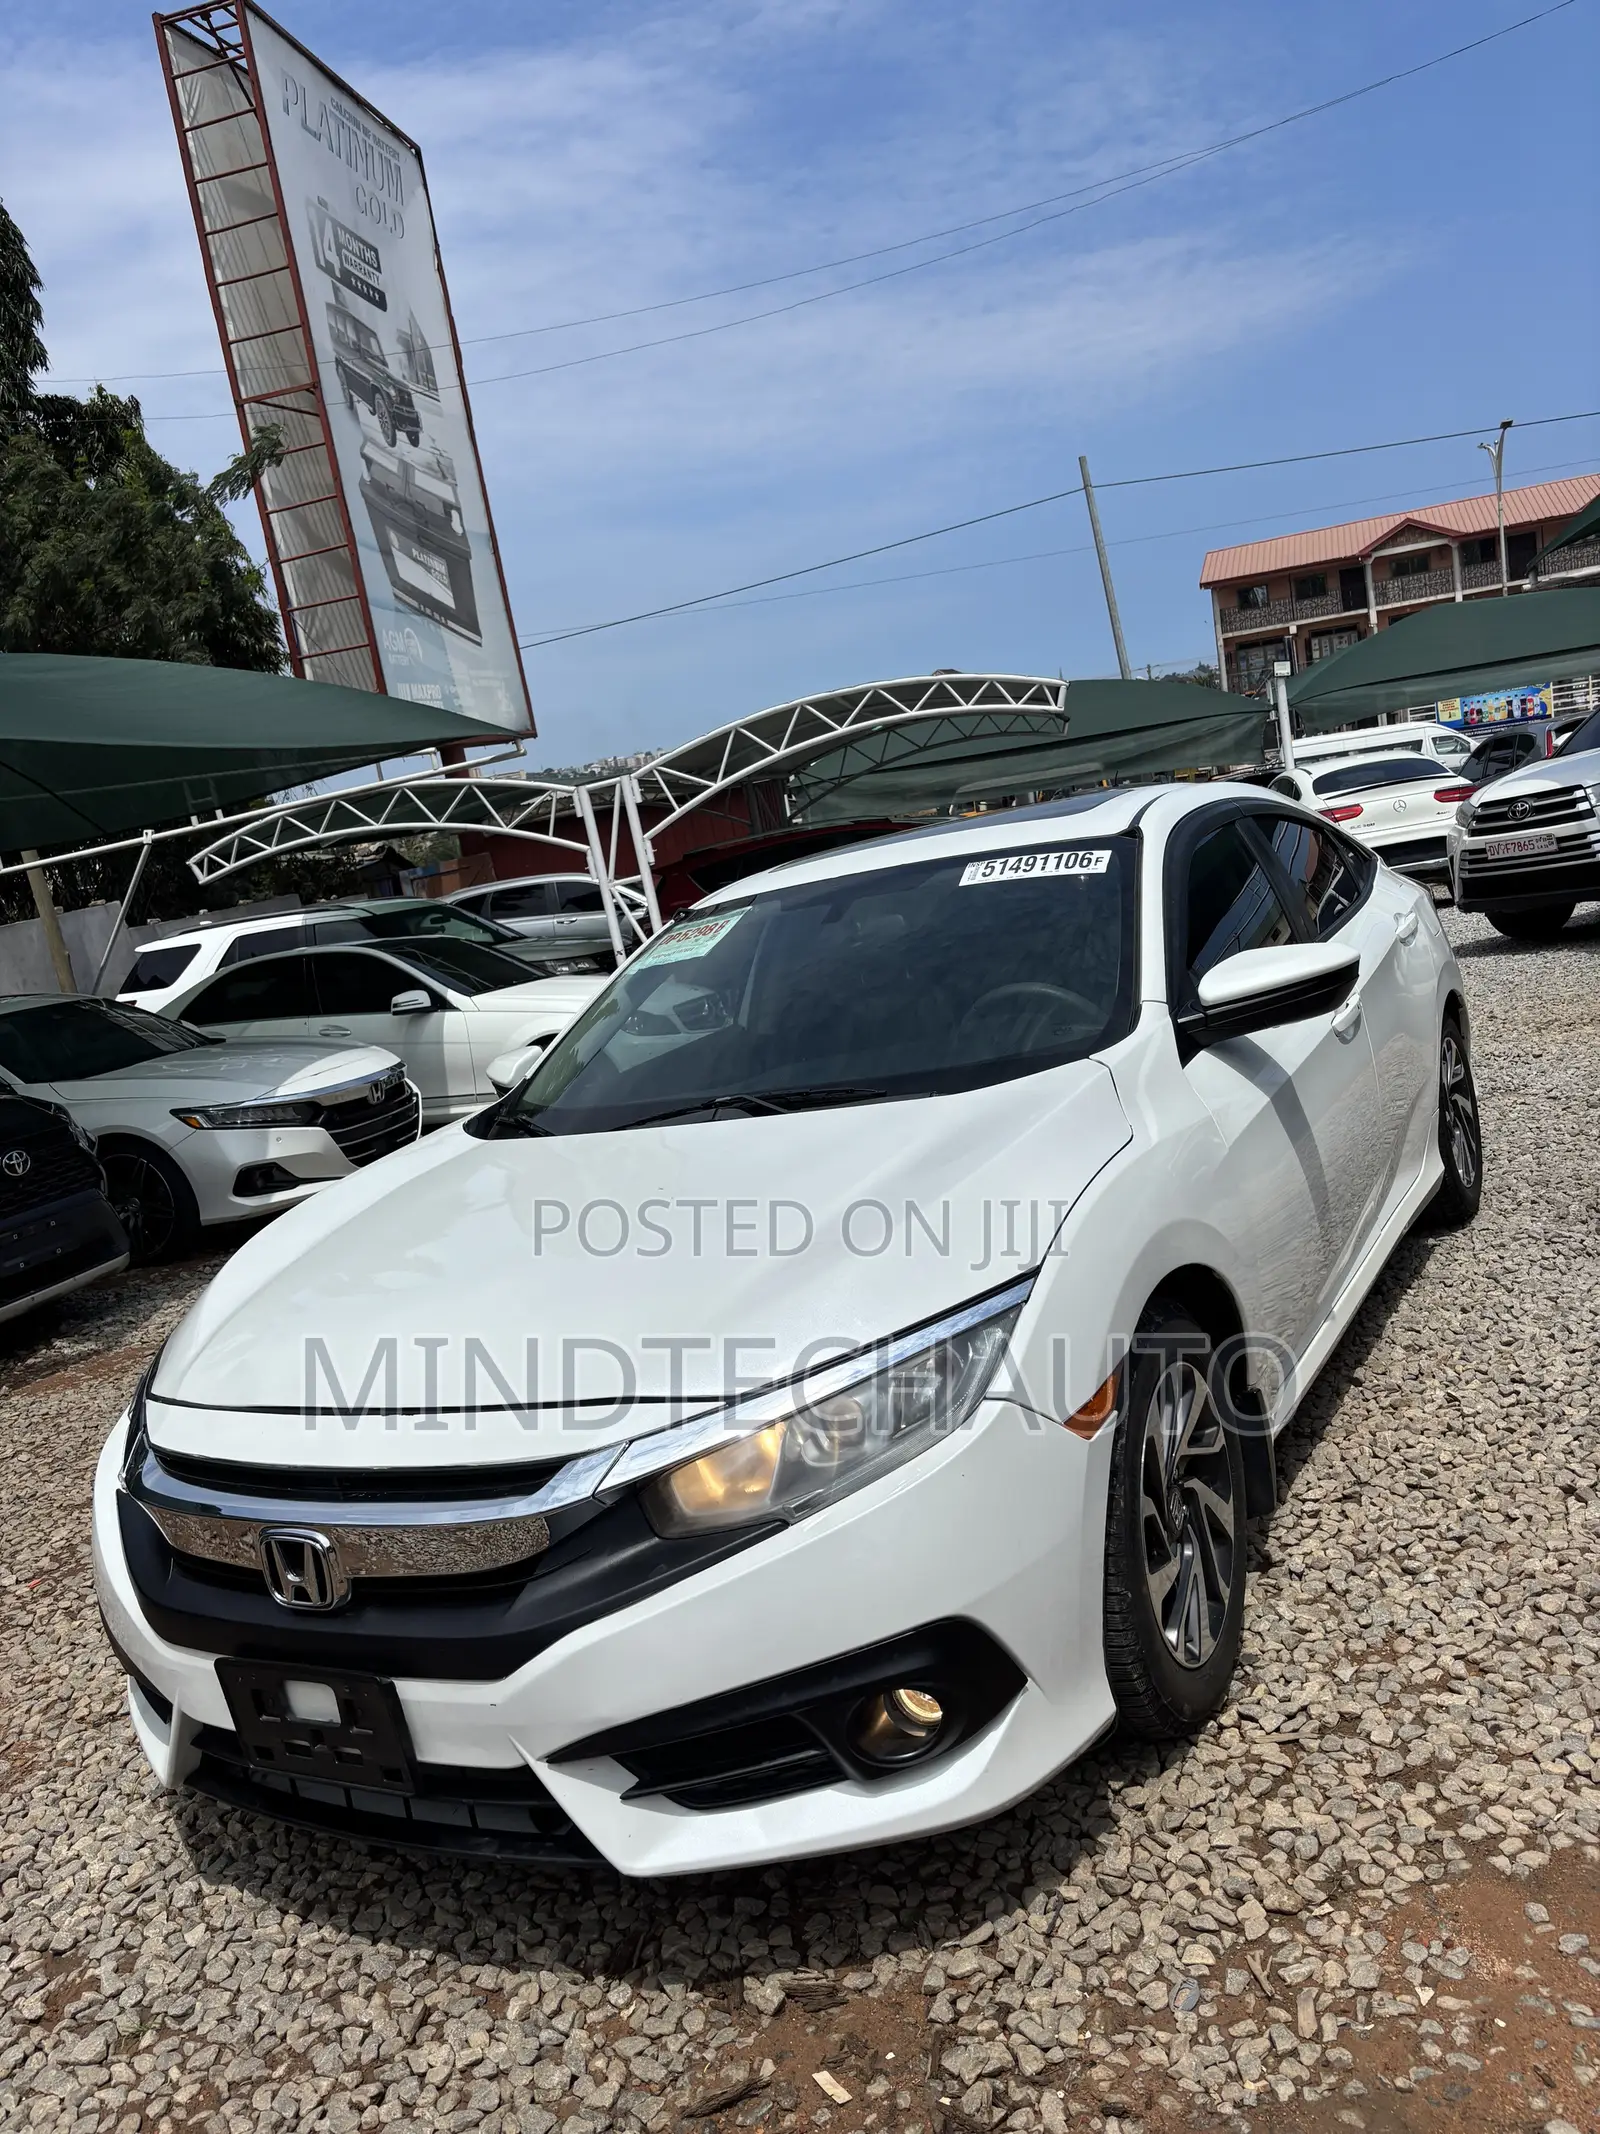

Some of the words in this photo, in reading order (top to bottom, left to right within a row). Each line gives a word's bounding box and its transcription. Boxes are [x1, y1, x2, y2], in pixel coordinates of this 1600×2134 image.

[281, 70, 404, 207] PLATINUM
[356, 183, 405, 240] GOLD
[336, 226, 379, 269] MONTHS
[343, 255, 380, 287] WARRANTY
[981, 851, 1094, 878] 51491106
[1095, 856, 1104, 866] F
